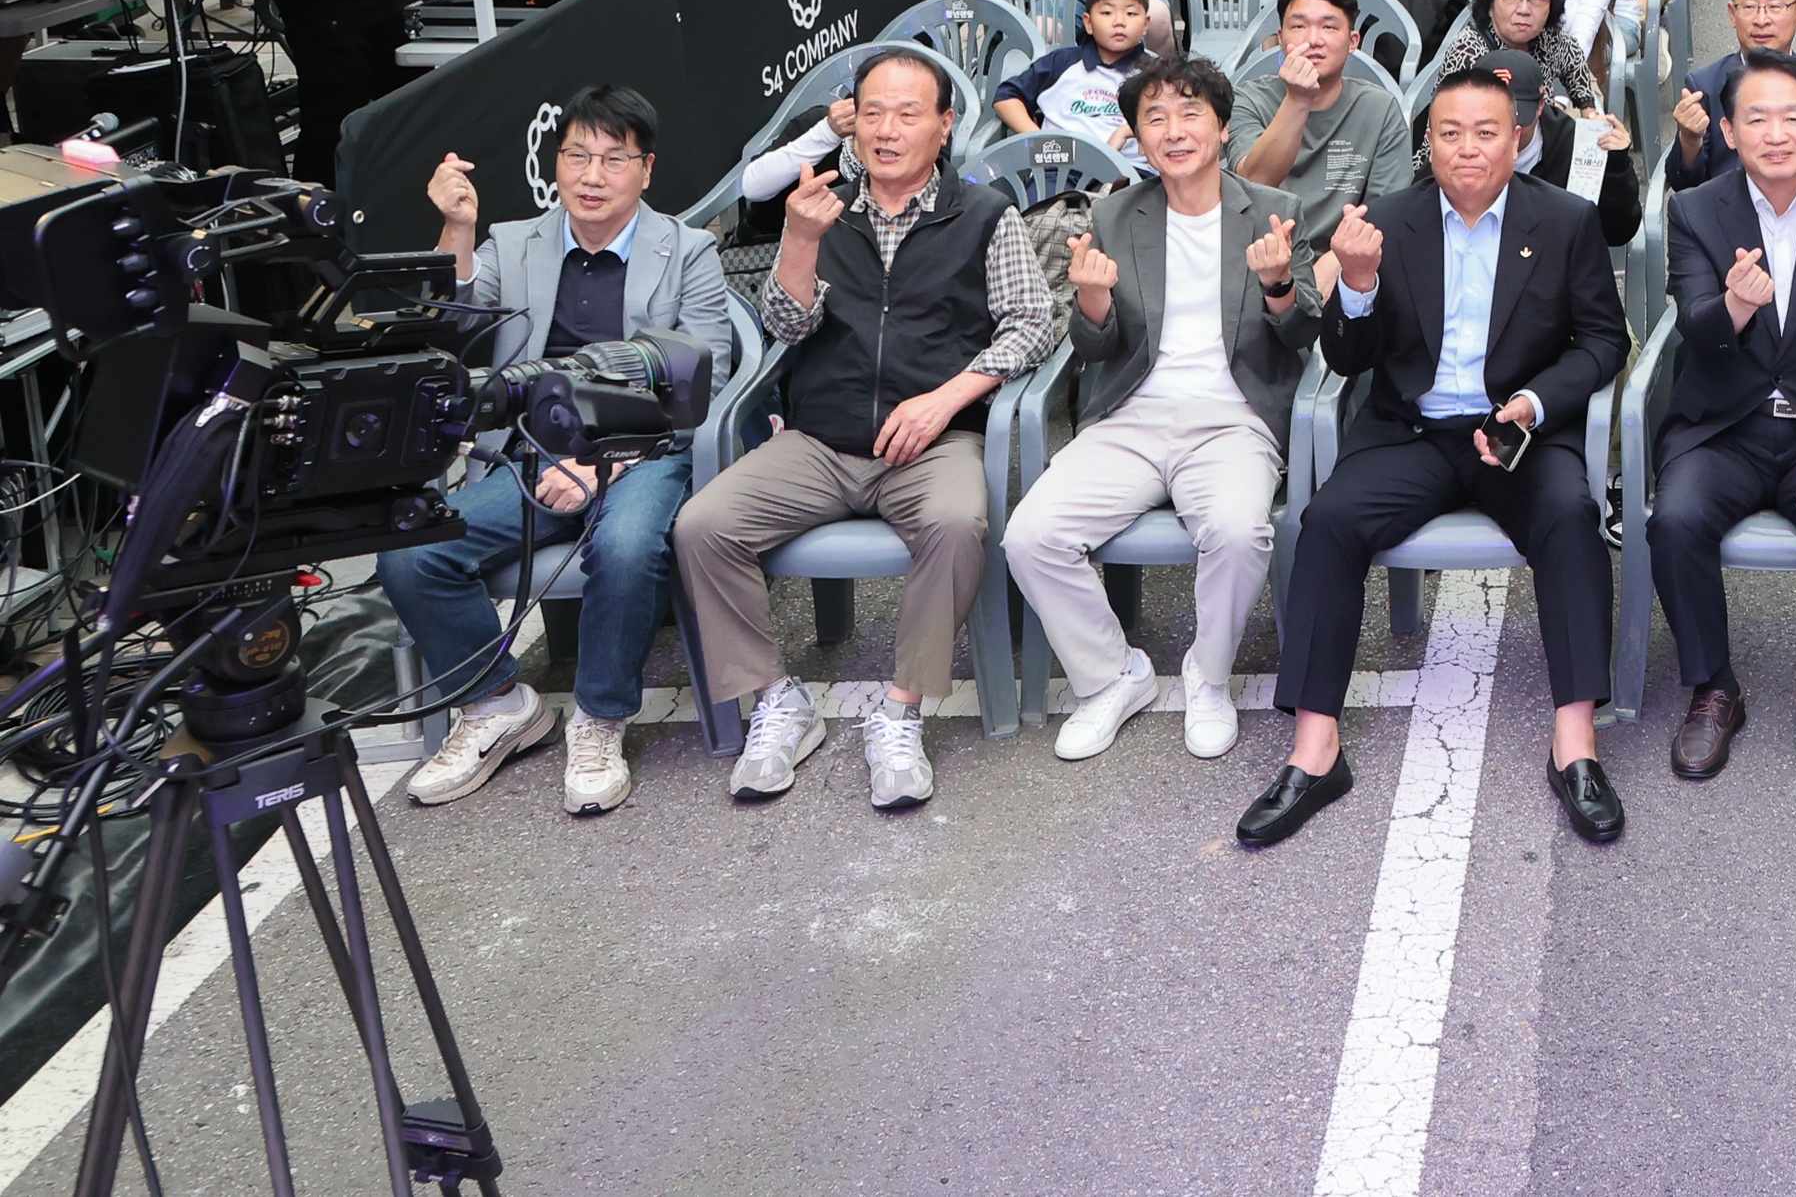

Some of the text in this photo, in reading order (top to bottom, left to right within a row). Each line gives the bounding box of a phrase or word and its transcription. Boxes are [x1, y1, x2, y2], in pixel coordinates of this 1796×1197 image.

[762, 9, 858, 97] S4 COMPANY
[1034, 152, 1069, 164] 청년렌탈
[603, 449, 641, 459] Canon
[255, 782, 305, 810] TERIS
